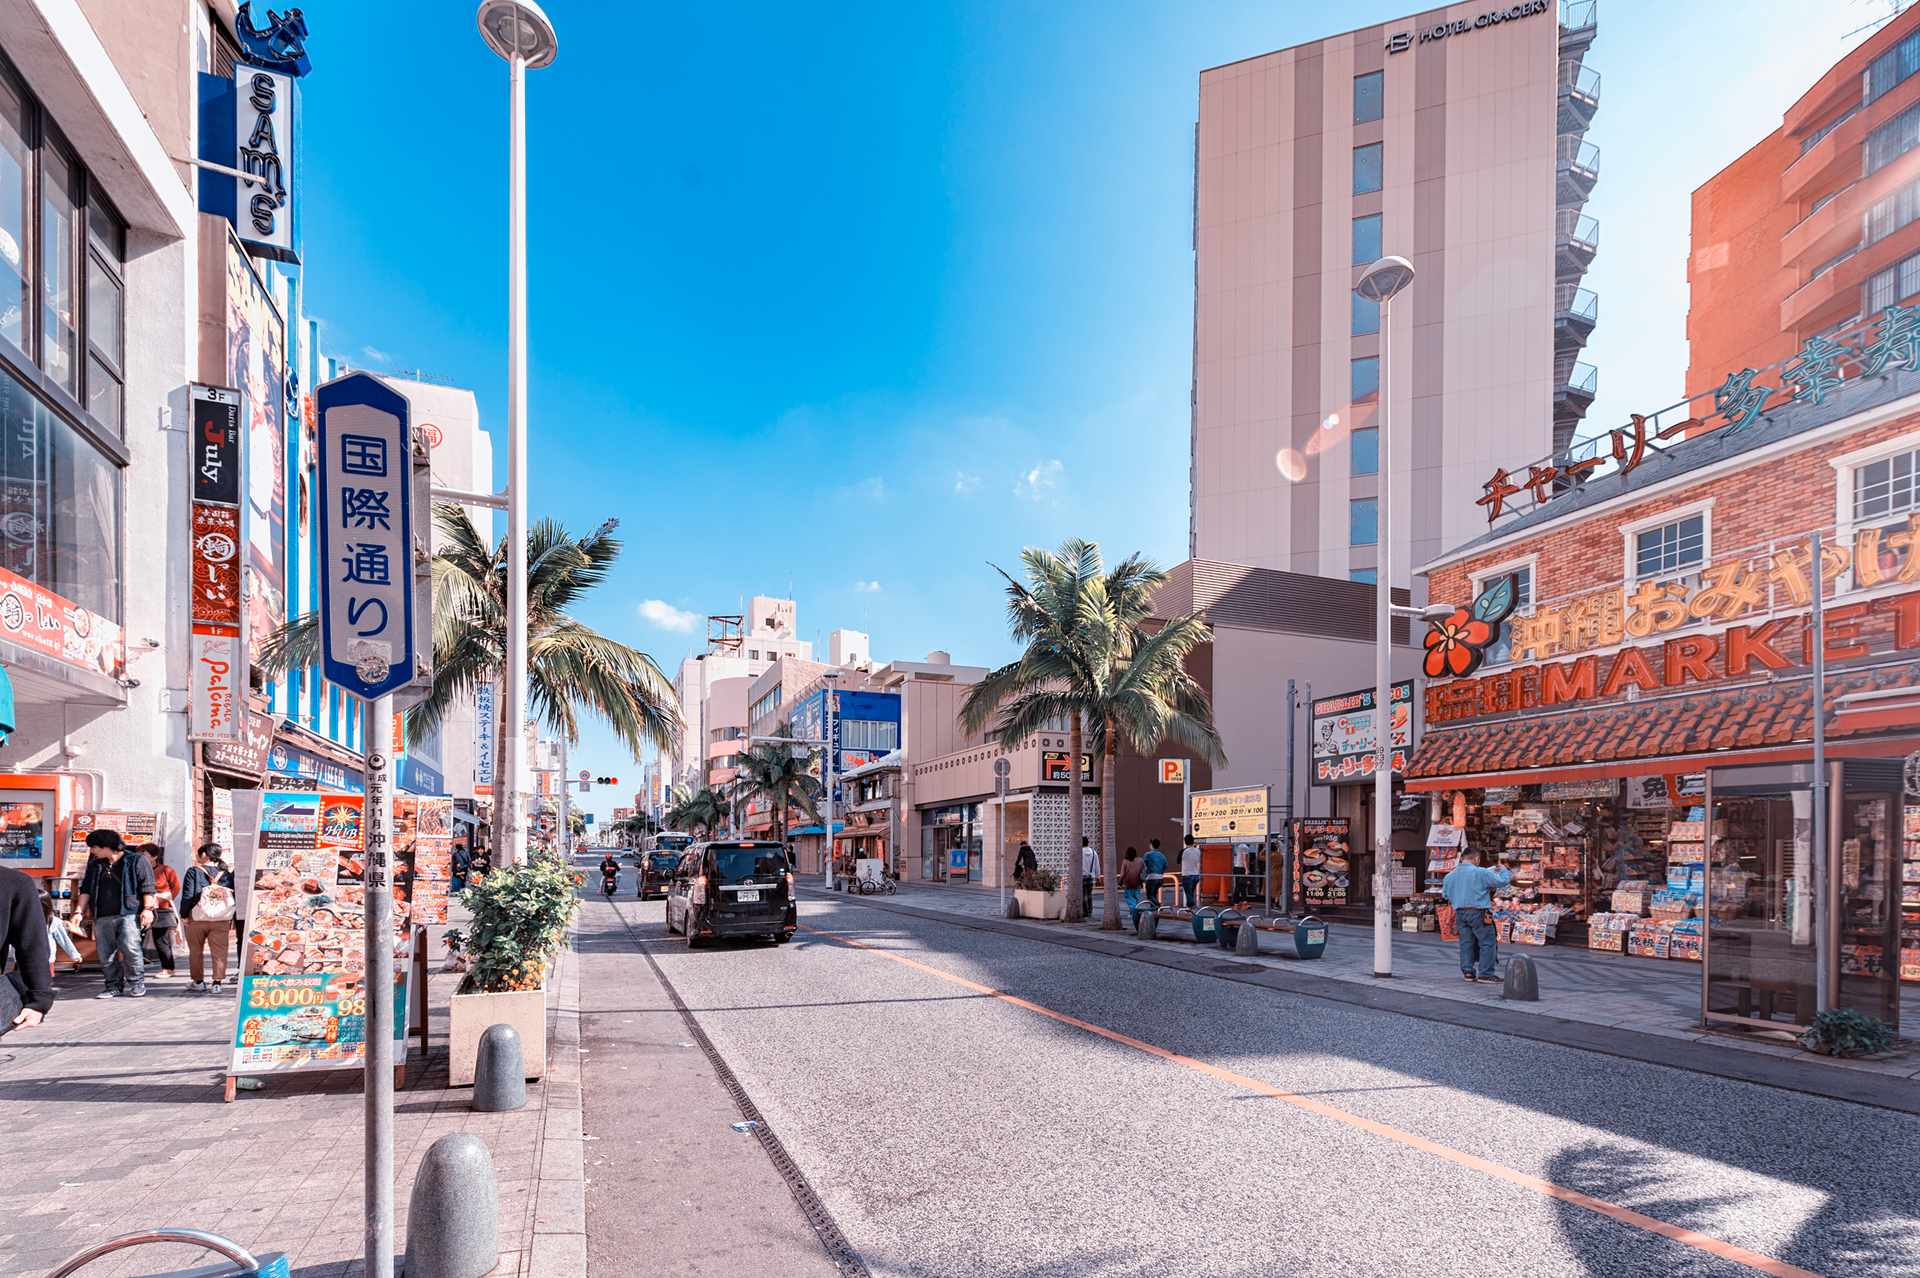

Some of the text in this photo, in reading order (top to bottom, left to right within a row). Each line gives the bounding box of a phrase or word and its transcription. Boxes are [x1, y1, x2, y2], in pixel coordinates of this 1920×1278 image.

[1420, 0, 1551, 45] HOTEL GRACERY
[207, 388, 226, 402] 3F
[228, 405, 236, 444] Darts Bar
[201, 420, 225, 484] July
[340, 433, 392, 638] 国際通り
[210, 626, 224, 635] 1F
[1540, 591, 1920, 704] MARKET
[200, 656, 230, 730] Paloma
[1315, 685, 1410, 715] CHARLIE'S TCOS
[1164, 761, 1178, 781] P
[1195, 796, 1207, 809] P
[323, 824, 358, 839] HUB
[1629, 936, 1655, 947] 免税
[1671, 939, 1699, 950] 免税
[269, 977, 322, 988] 食べ飲み放題
